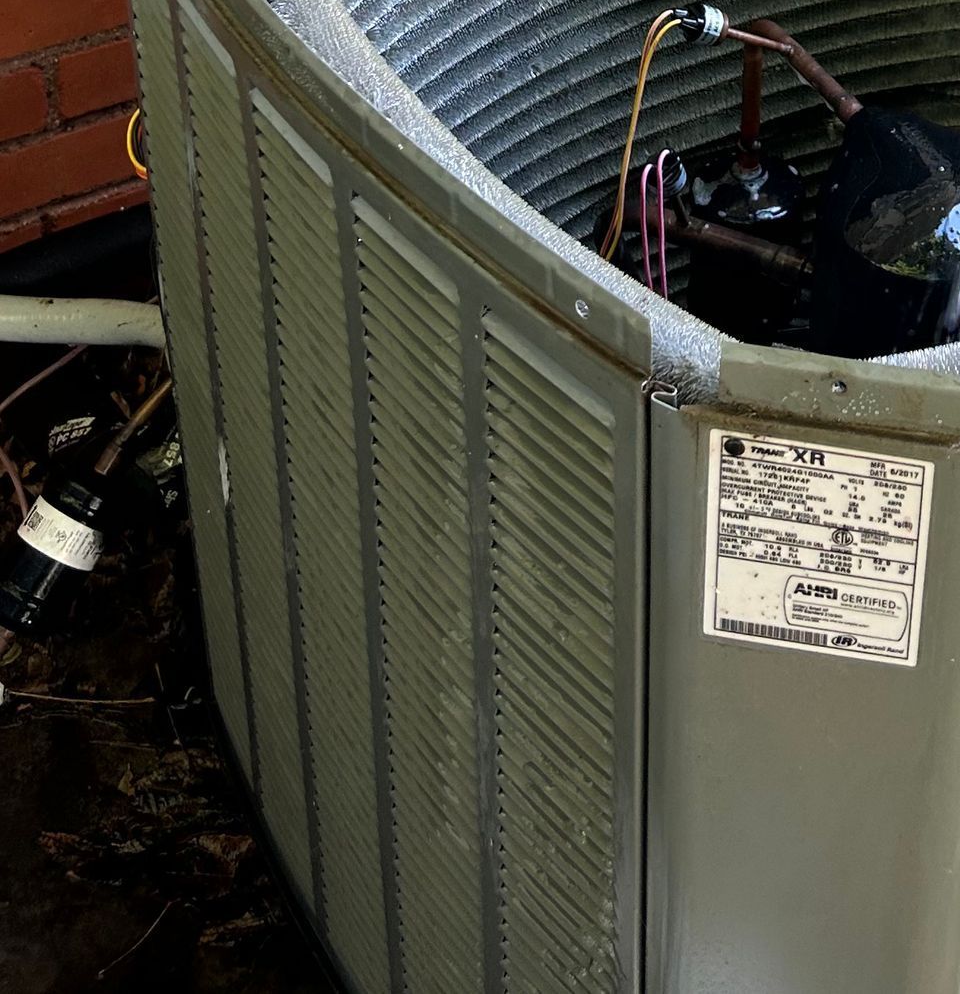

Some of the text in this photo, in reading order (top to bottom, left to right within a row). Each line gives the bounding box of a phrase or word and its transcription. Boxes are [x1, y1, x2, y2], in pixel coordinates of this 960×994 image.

[751, 445, 825, 466] TRANE XR
[869, 468, 918, 479] DATE 6/2017
[721, 474, 751, 483] MINIMUM
[753, 479, 777, 487] CIRCUIT
[848, 477, 864, 485] VOLTS
[721, 481, 826, 502] OVERCURRENT PROTECTIVE DEVICE
[758, 493, 785, 502] BREAKER
[721, 511, 749, 521] TRANE
[793, 581, 896, 609] AHRI CERTIFIED
[856, 641, 885, 652] Ingersoll
[887, 647, 904, 655] Rand
